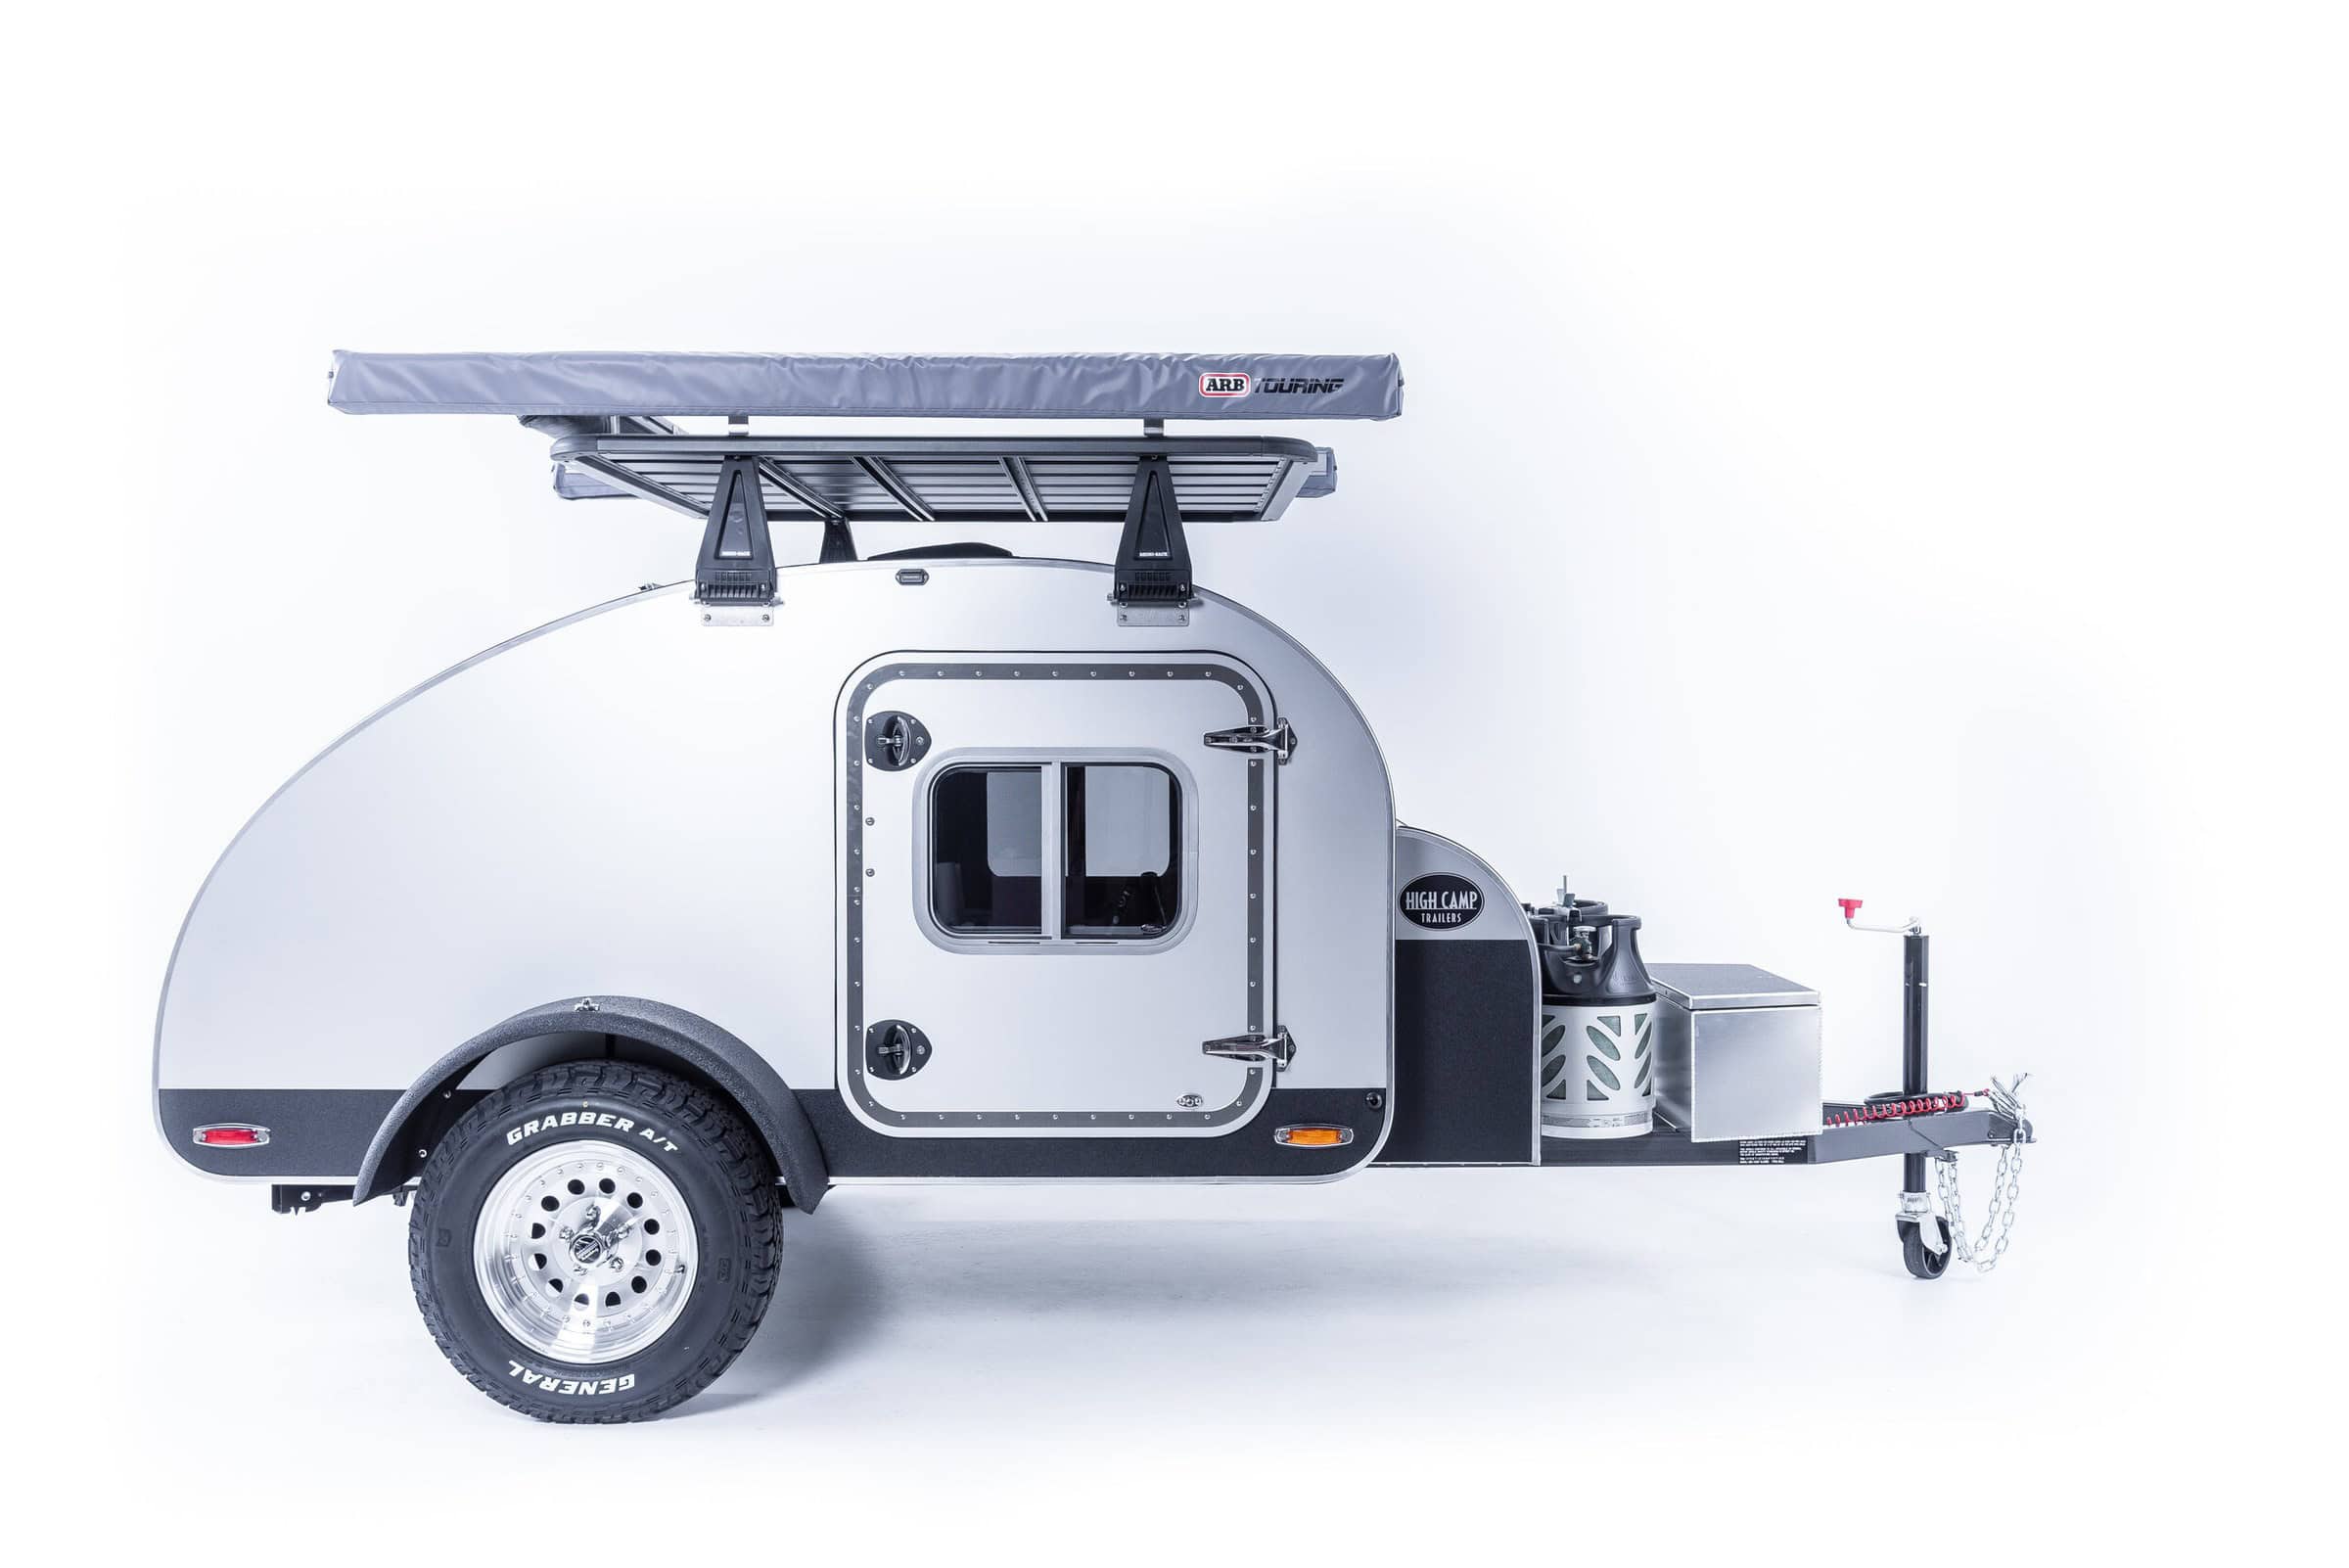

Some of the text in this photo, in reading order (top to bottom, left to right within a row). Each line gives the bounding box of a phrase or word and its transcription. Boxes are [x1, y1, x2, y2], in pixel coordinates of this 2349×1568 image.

[1205, 377, 1345, 393] ARB TOURING
[1405, 891, 1478, 909] HIGH CAMP
[1421, 912, 1462, 923] TRAILERS
[506, 1111, 678, 1152] GRABBER A/T
[508, 1360, 635, 1395] GENERAL
